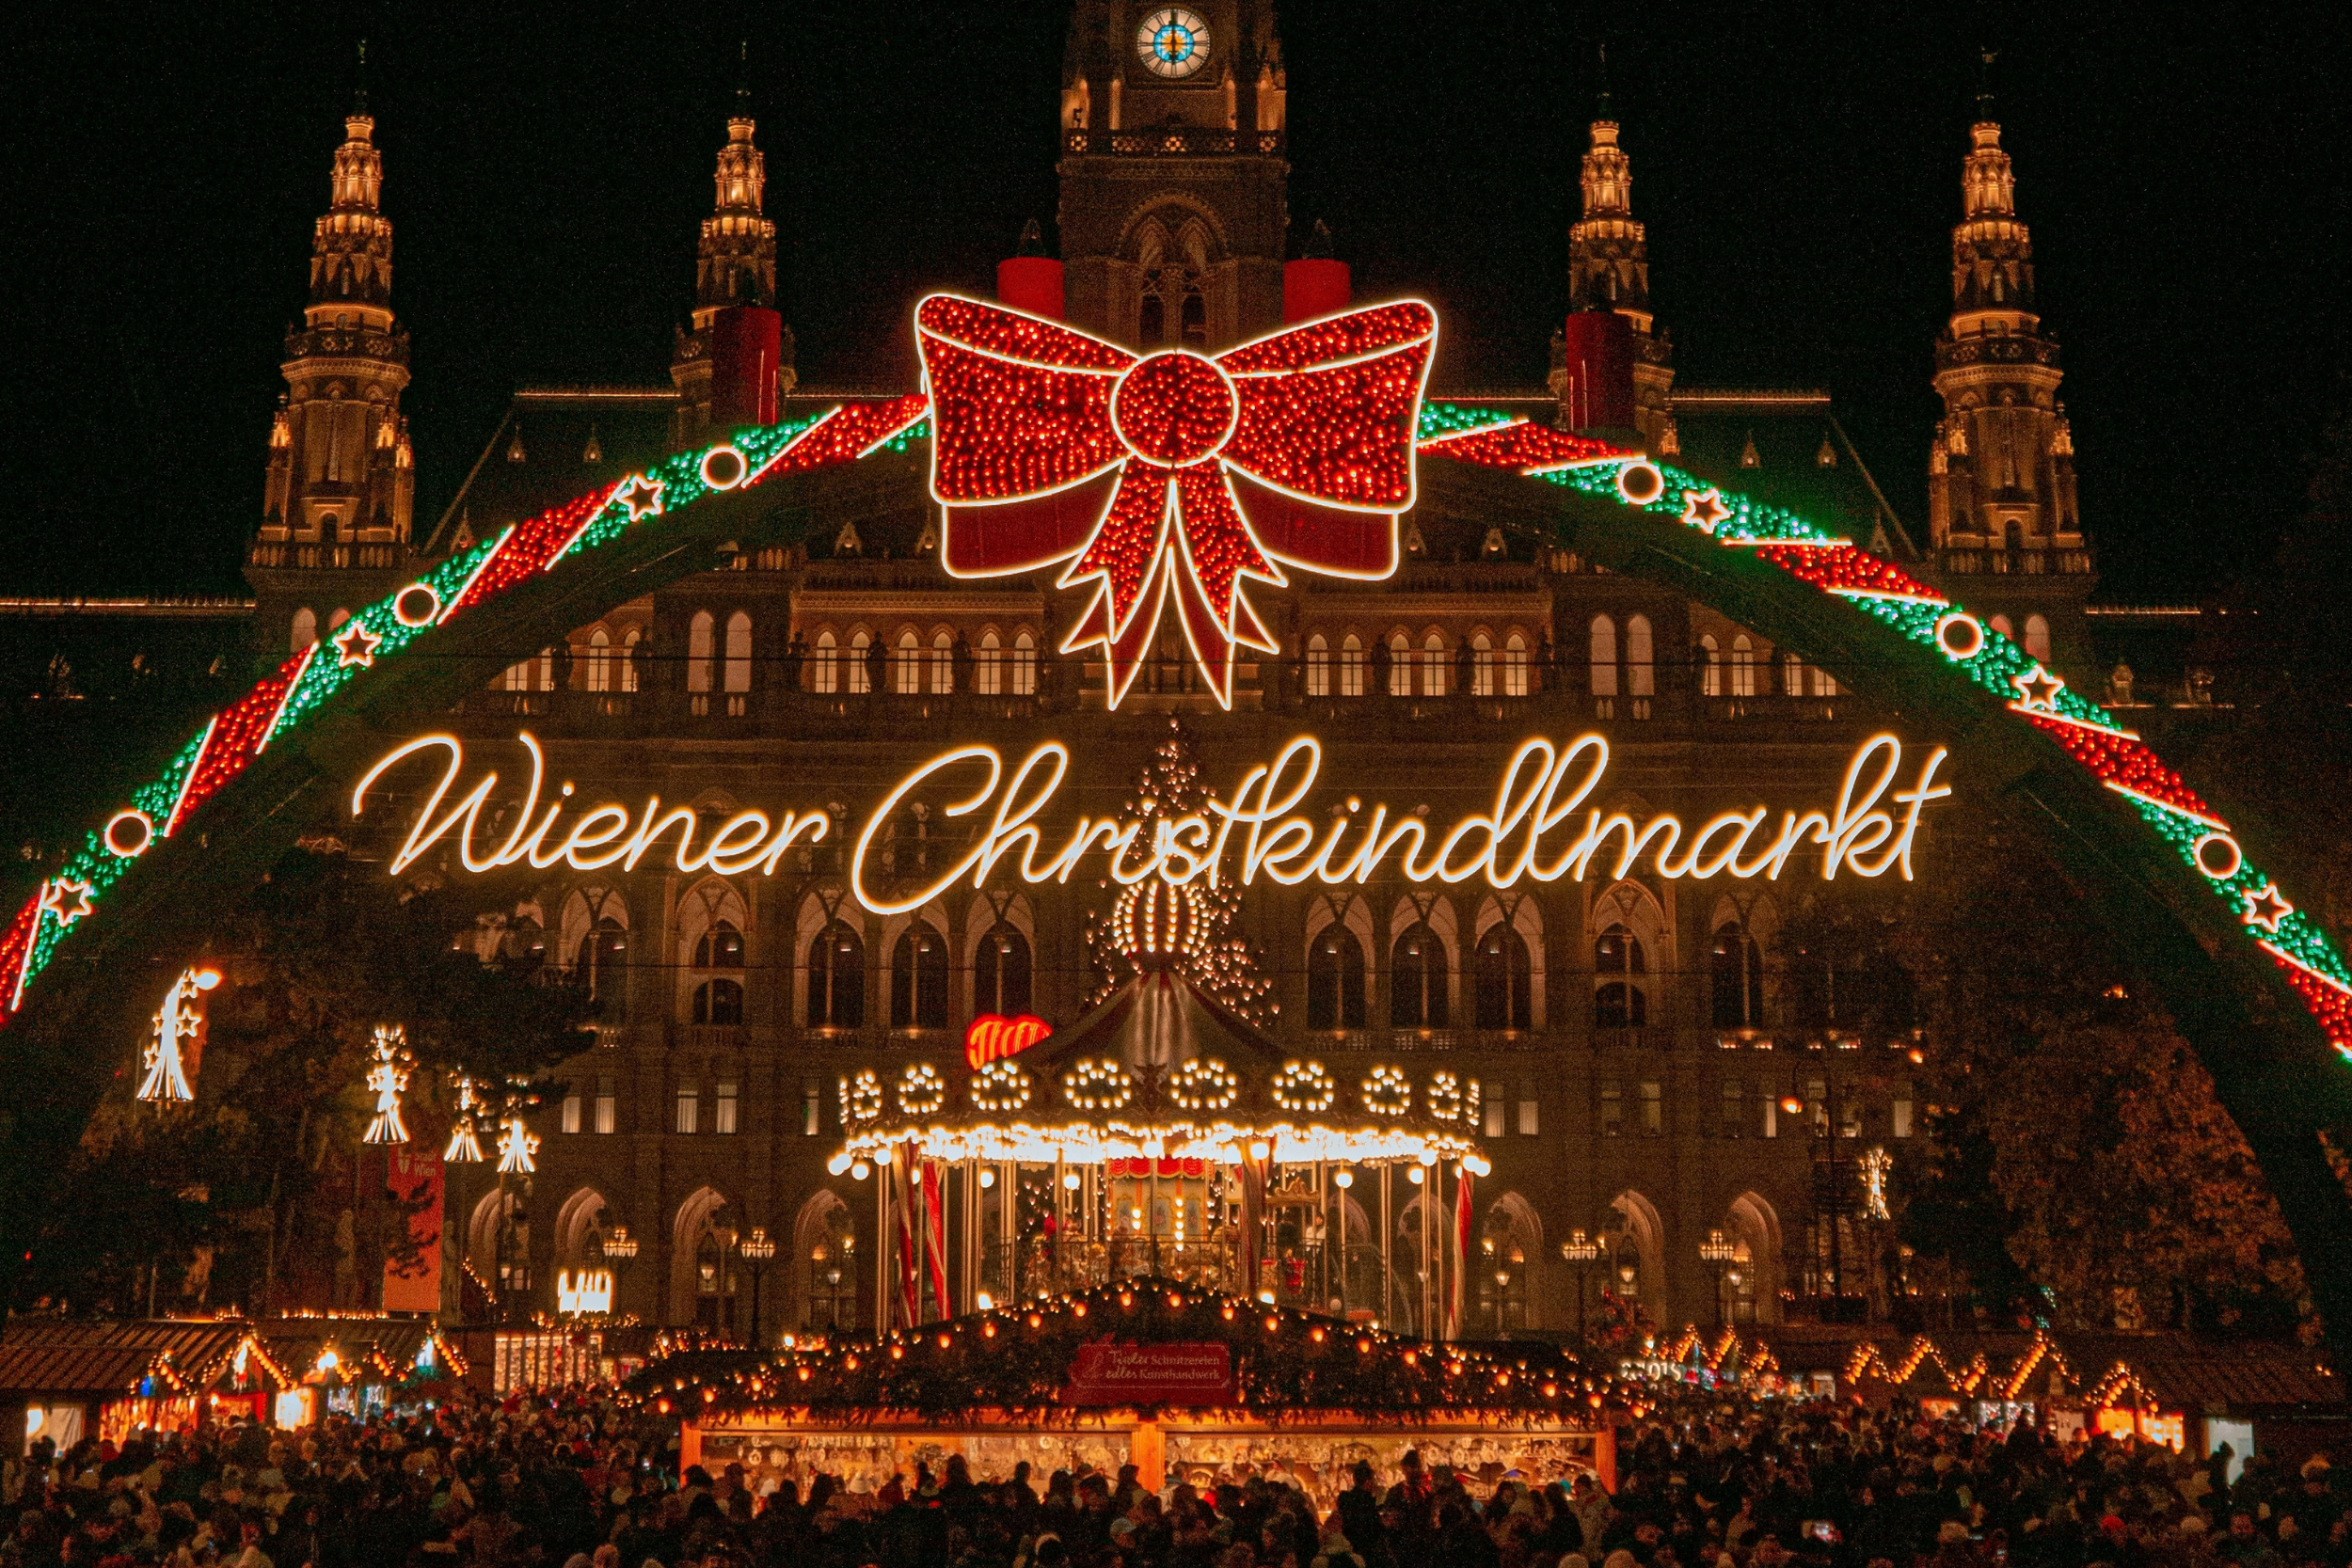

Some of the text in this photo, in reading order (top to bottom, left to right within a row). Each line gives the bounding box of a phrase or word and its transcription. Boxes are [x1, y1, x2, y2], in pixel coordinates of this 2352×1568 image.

[351, 733, 1953, 917] Wiener Christkindlmarkt
[1151, 1354, 1220, 1365] Schnitzereien
[1139, 1368, 1220, 1380] Kunsthandwerk
